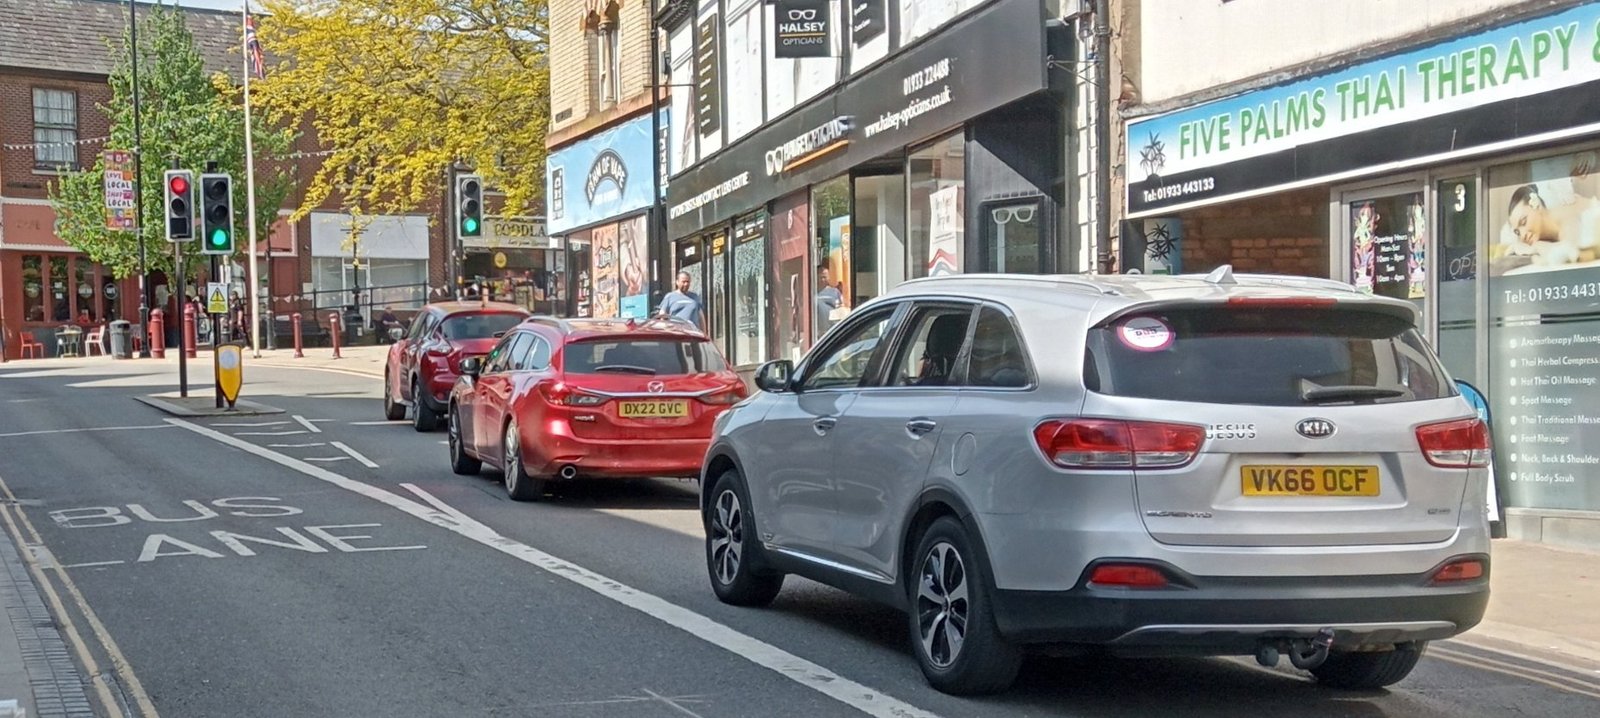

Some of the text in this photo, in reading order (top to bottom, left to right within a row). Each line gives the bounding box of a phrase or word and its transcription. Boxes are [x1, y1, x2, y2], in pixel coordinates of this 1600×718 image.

[779, 22, 825, 34] HALSEY
[783, 37, 823, 46] OPTICIANS
[1179, 114, 1231, 160] FIVE
[1240, 88, 1327, 147] PALMS
[1336, 67, 1405, 122] THAI
[1417, 22, 1579, 103] THERAPY
[602, 156, 610, 175] OF
[107, 181, 131, 189] LOCAL
[1143, 177, 1215, 203] Tel: 01933 443133
[108, 199, 131, 207] LOCAL
[1455, 184, 1466, 212] 3
[1373, 236, 1394, 245] Opening
[1504, 289, 1527, 304] Tel:
[1528, 285, 1568, 302] 01933
[1521, 336, 1572, 347] Aromatherapy
[1521, 357, 1537, 367] Thai
[1537, 357, 1561, 367] Herbal
[1550, 375, 1563, 386] Oil
[1563, 375, 1597, 386] Massage
[1540, 395, 1573, 407] Massage
[624, 402, 682, 415] DX22 GVC
[1521, 415, 1537, 425] Thai
[1537, 415, 1577, 425] Traditional
[1206, 423, 1256, 440] JESUS
[1301, 422, 1332, 435] KIA
[1537, 433, 1570, 446] Massage
[1541, 453, 1559, 463] Back
[1566, 453, 1599, 464] Shoulder
[1250, 469, 1369, 492] VK66 OCF
[1521, 471, 1575, 485] Full Body Scrub
[48, 496, 304, 528] BUS
